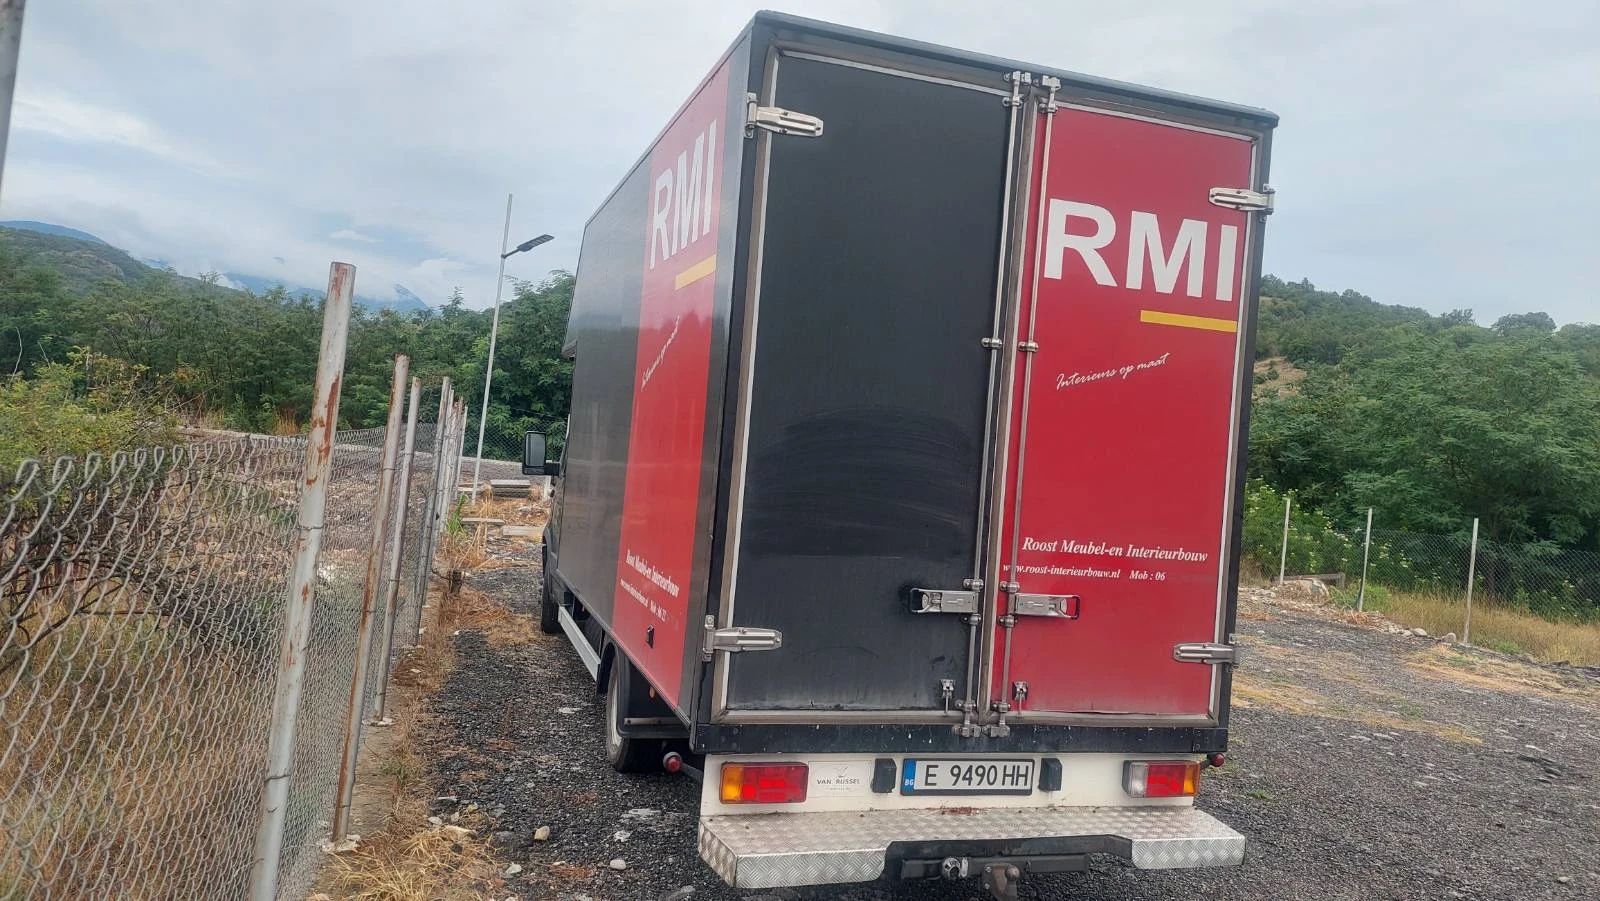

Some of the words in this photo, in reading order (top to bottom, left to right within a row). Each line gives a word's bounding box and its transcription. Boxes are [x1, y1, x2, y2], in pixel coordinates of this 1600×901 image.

[649, 119, 718, 270] RMI
[1043, 198, 1238, 303] RMI
[1056, 368, 1117, 391] Interieurs
[1119, 364, 1135, 380] op
[1136, 352, 1171, 370] maat
[1022, 536, 1058, 553] Roost
[1059, 539, 1123, 557] Meubel-en
[1125, 544, 1208, 563] Interieurbouw
[1003, 563, 1121, 579] ww.roost-interieurbouw.nl
[1129, 570, 1148, 581] Mob
[1154, 571, 1166, 581] 06
[904, 778, 914, 787] BG
[924, 764, 939, 787] E
[950, 764, 998, 787] 9490
[1002, 764, 1029, 787] HH
